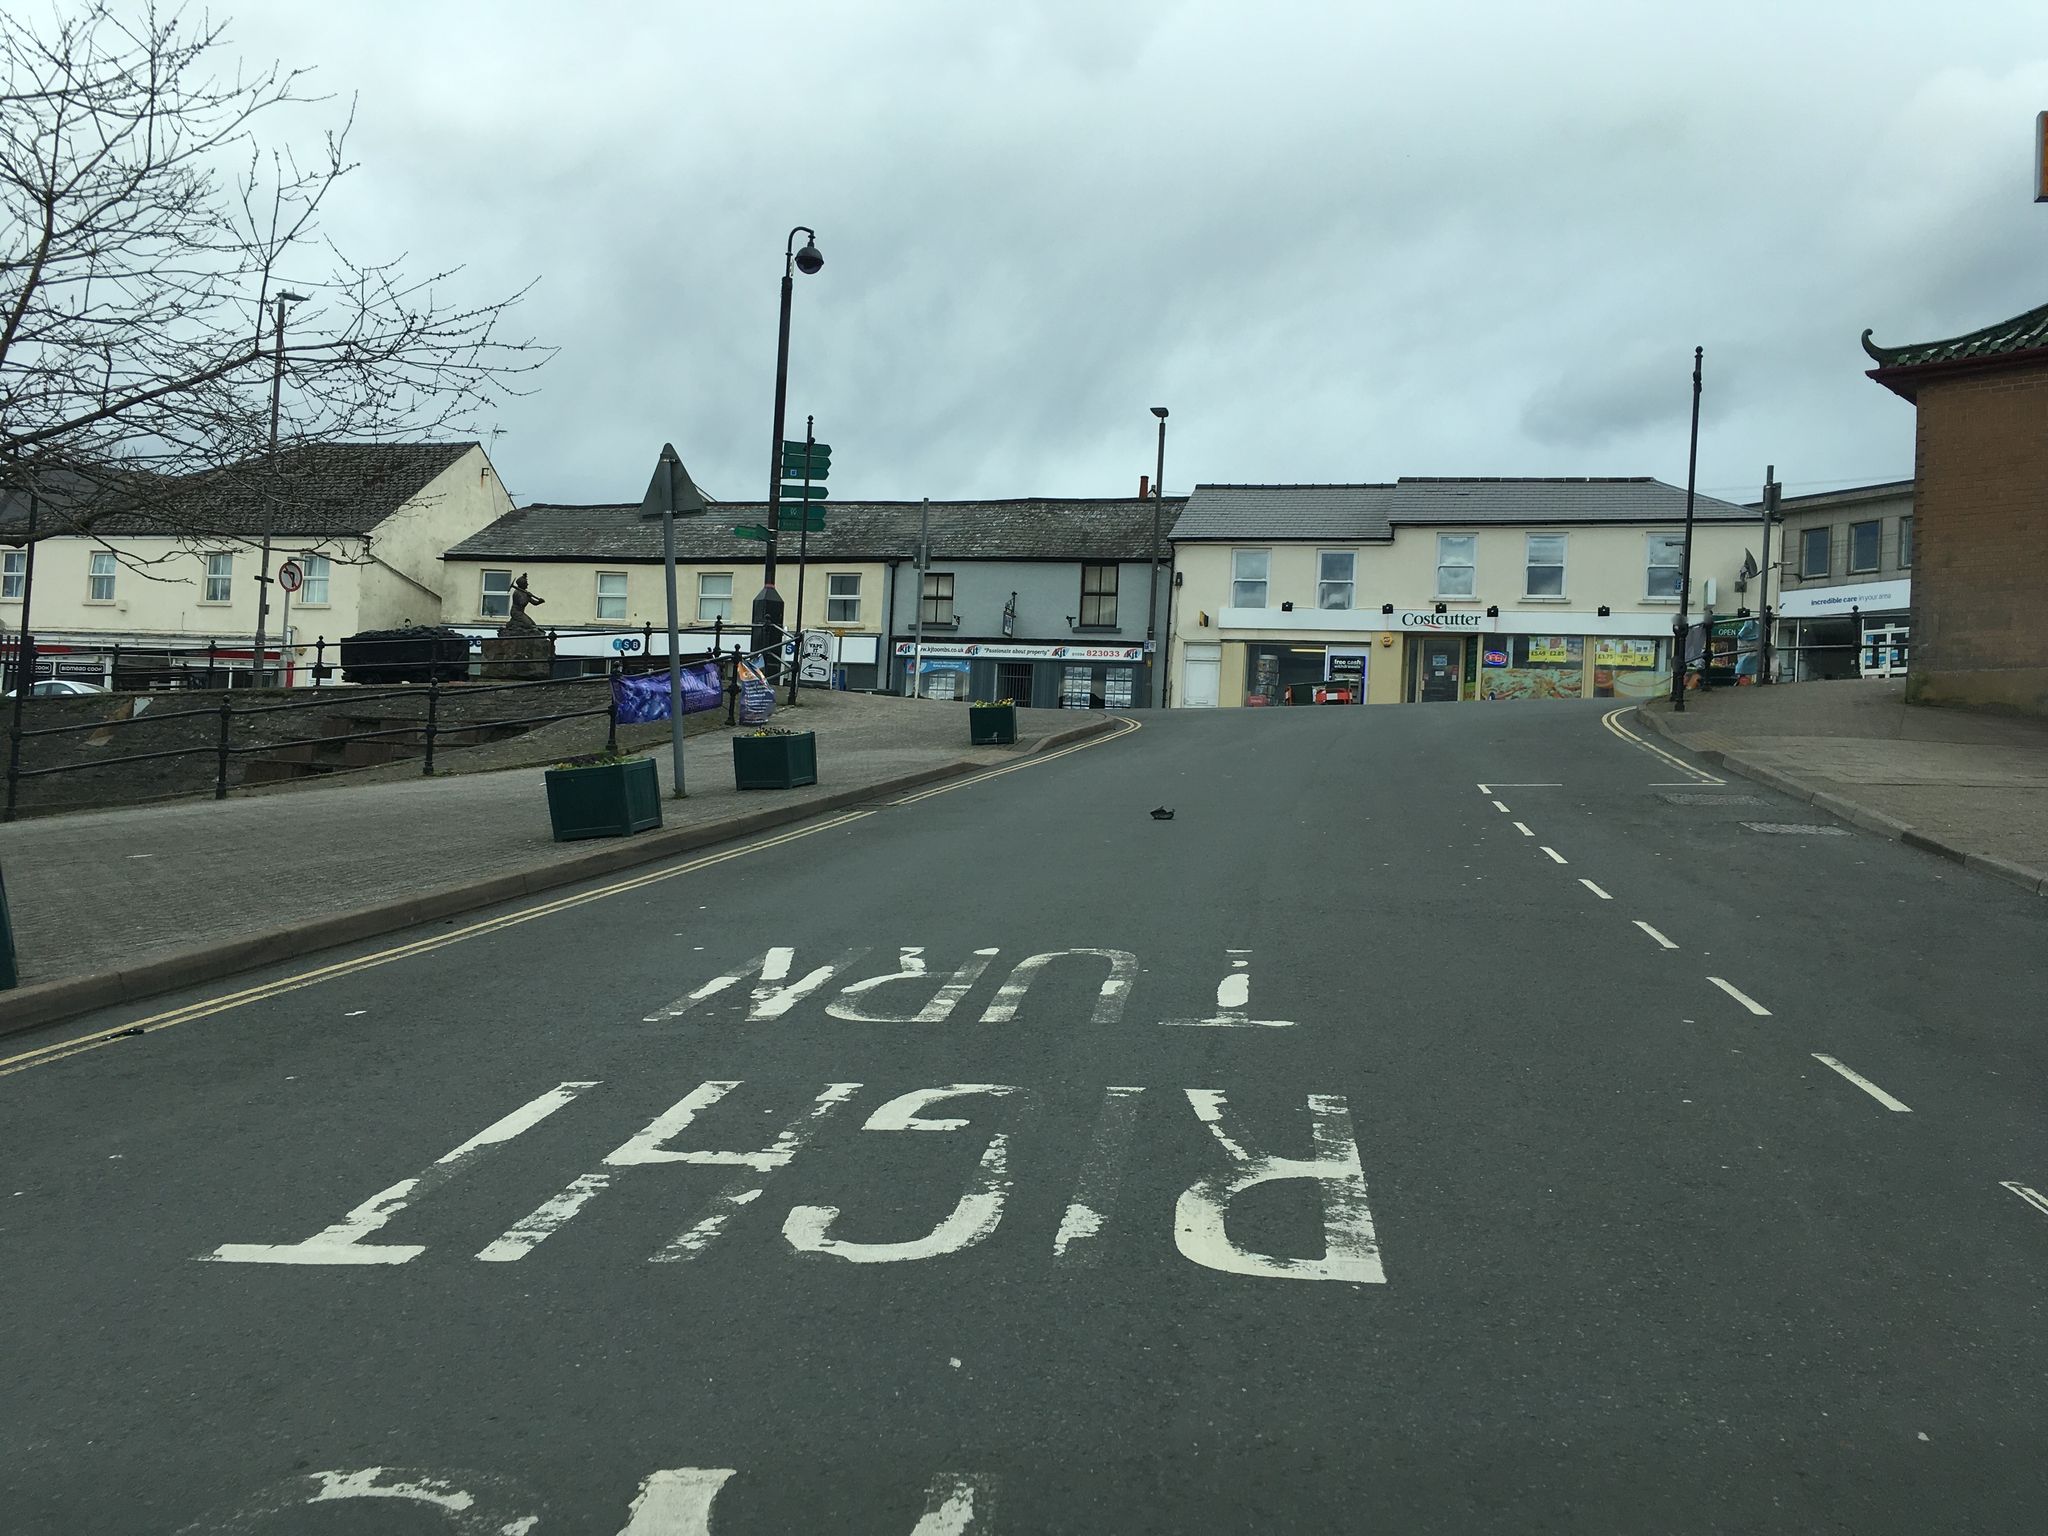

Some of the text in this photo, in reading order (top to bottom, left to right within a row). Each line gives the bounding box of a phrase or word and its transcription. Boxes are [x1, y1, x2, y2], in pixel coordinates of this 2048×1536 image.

[1811, 597, 1842, 606] incredible
[1402, 612, 1481, 626] Costcutter
[1718, 628, 1736, 636] OPEN
[614, 640, 639, 650] TSB
[641, 945, 1296, 1029] TURN
[193, 1081, 1387, 1286] RIGHT
